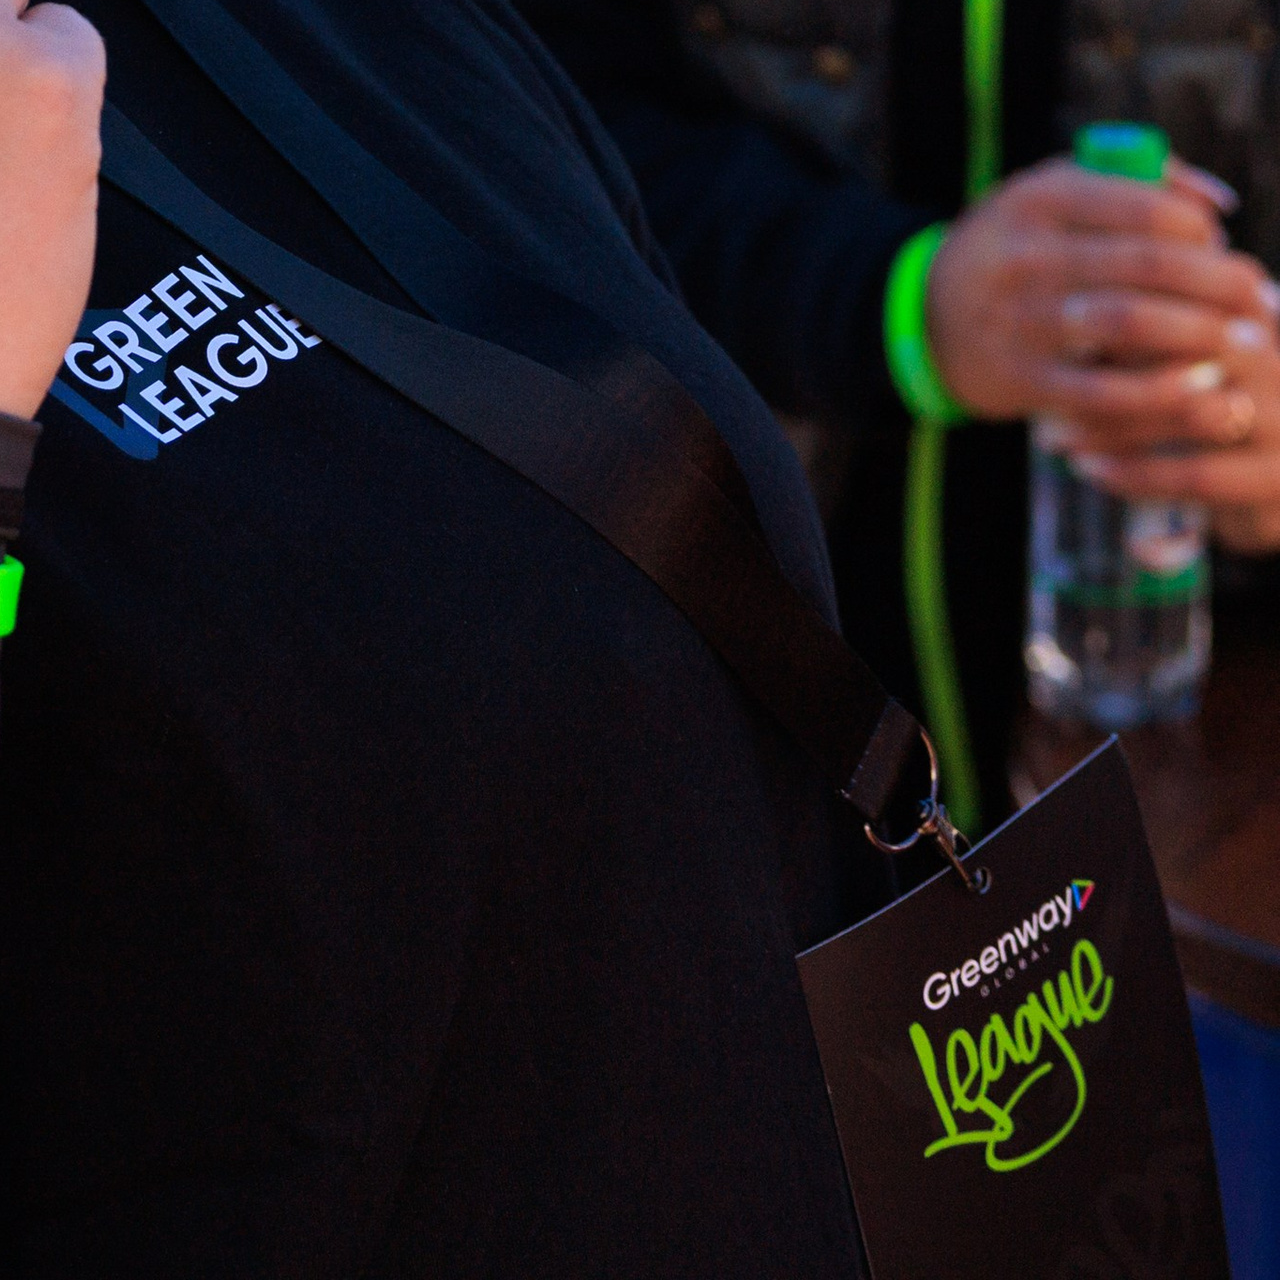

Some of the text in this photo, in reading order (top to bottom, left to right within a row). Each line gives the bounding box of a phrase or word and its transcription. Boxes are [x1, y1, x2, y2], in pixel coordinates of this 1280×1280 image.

[64, 254, 245, 390] GREEN
[118, 303, 322, 443] LEAGUE
[923, 886, 1072, 1010] Greenway
[909, 939, 1114, 1172] League
